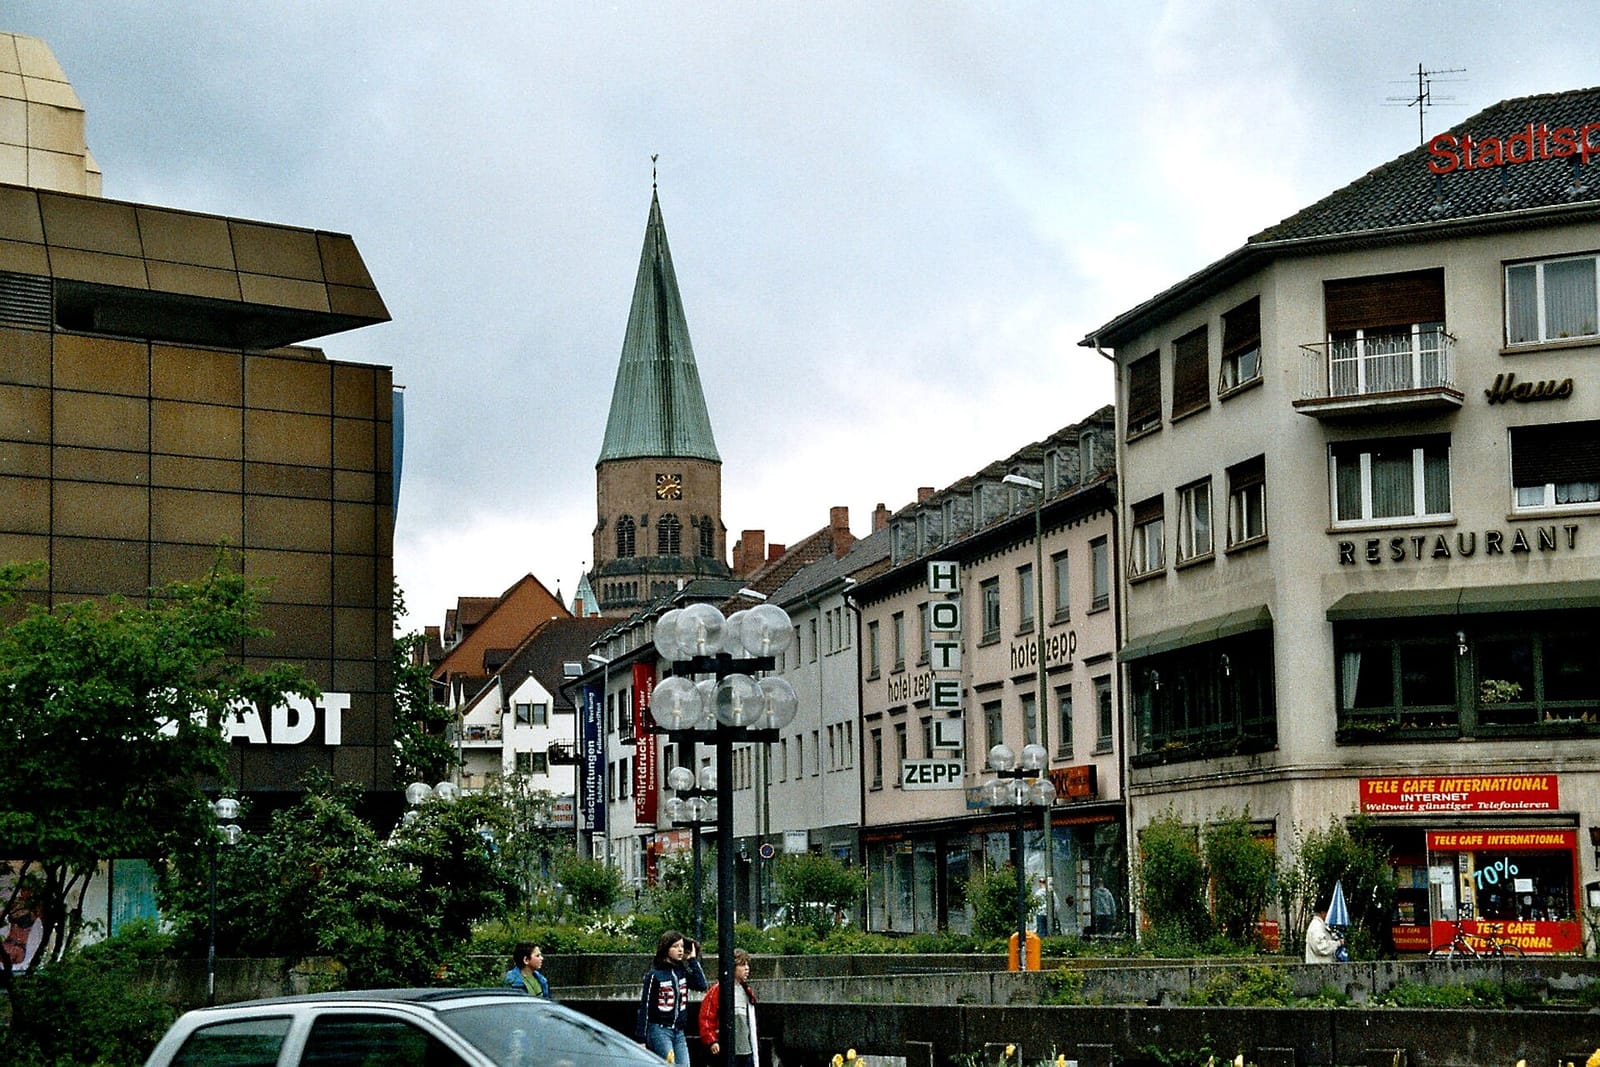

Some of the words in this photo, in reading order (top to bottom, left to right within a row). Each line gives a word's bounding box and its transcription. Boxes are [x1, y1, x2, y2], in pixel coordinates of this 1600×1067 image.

[1484, 372, 1574, 405] Haus
[1337, 524, 1579, 565] RESTAURANT
[933, 564, 959, 747] HOTEL
[1045, 630, 1077, 664] zepp
[888, 672, 911, 702] hotel
[586, 739, 597, 829] Beschriftungen
[637, 737, 647, 816] T-Shirtdruck
[904, 764, 961, 784] ZEPP
[1368, 781, 1398, 793] TELE
[1402, 780, 1435, 793] CAFE
[1439, 777, 1549, 792] INTERNATIONAL
[1366, 801, 1413, 811] Weltweit
[1418, 801, 1473, 812] günstiger
[1477, 801, 1549, 810] Telefonieren
[1400, 793, 1469, 802] INTERNET
[1434, 836, 1456, 845] TELE
[1459, 835, 1483, 845] CAFE
[1487, 834, 1565, 845] INTERNATIONAL
[1473, 857, 1518, 889] 70%
[1507, 922, 1536, 934] CAFE
